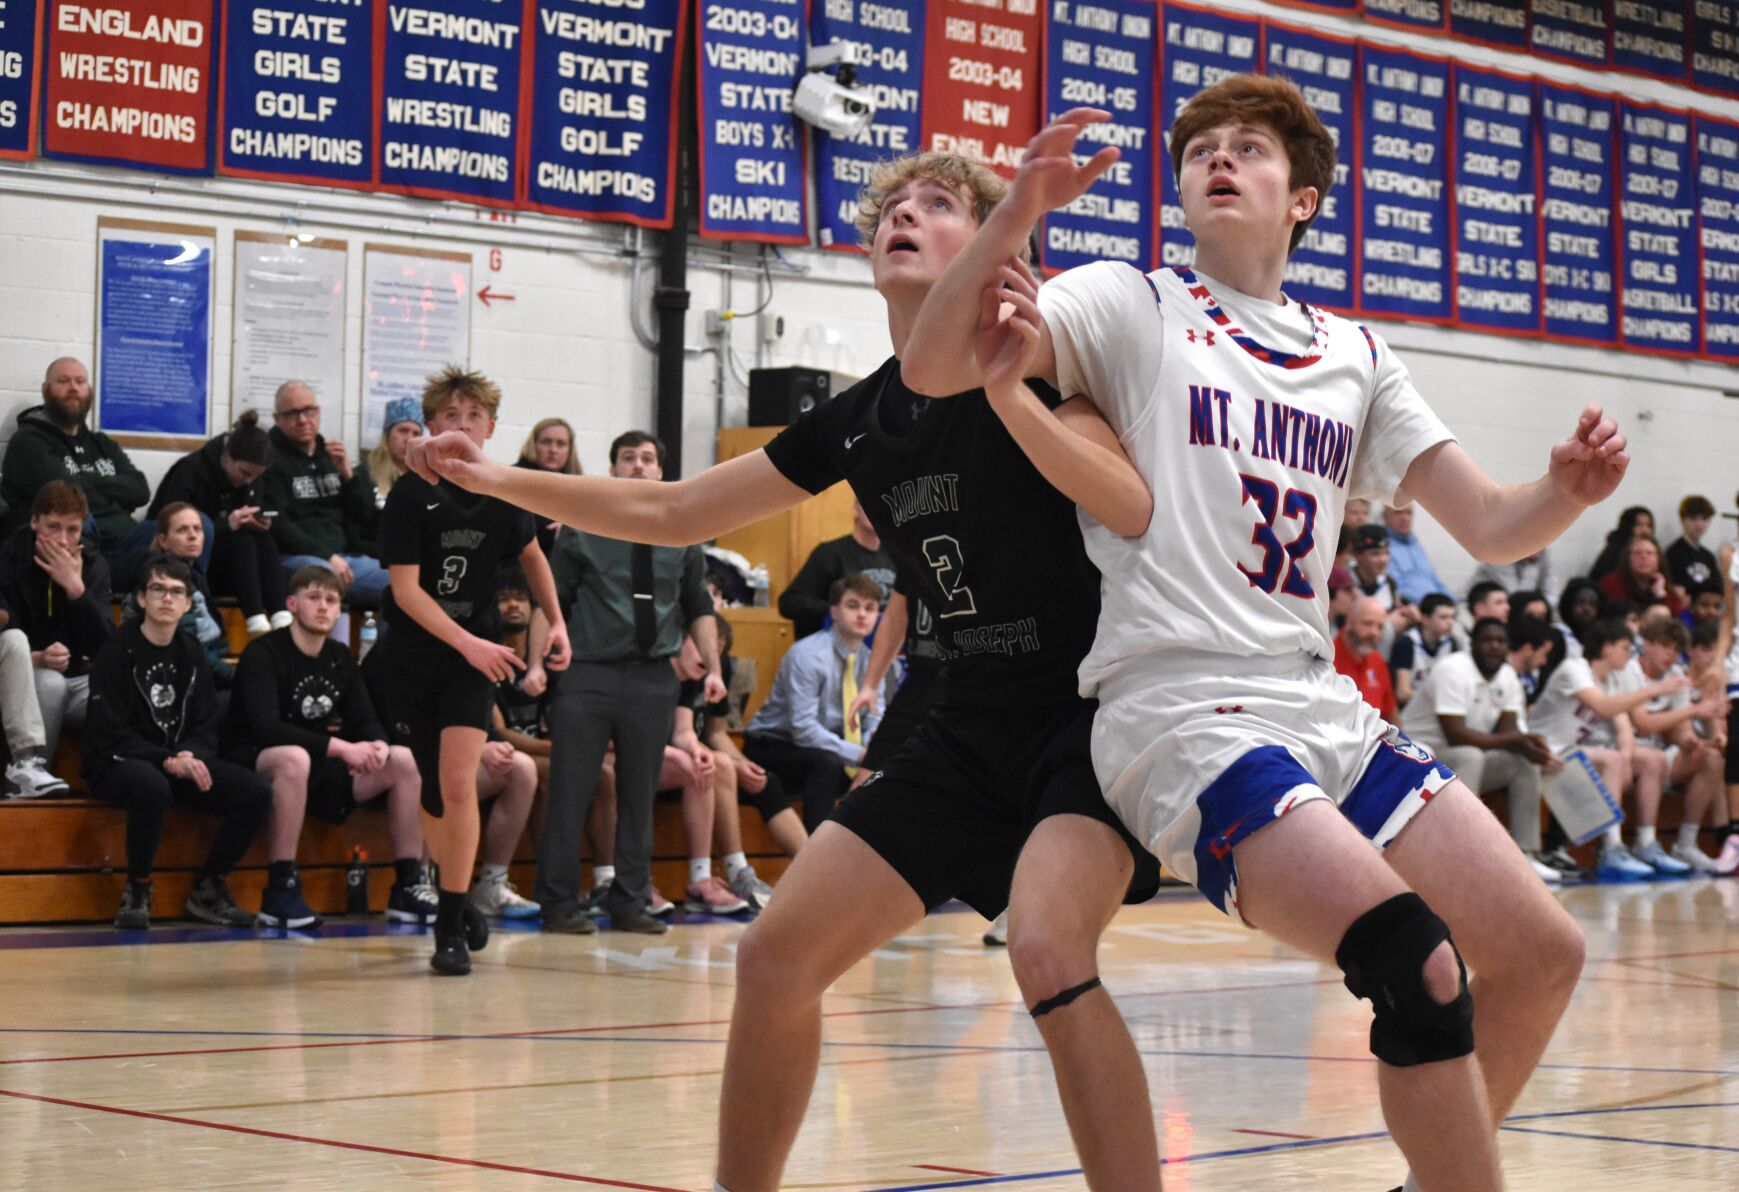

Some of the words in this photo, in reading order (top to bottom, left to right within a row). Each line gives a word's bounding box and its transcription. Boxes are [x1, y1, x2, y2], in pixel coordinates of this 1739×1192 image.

[58, 5, 203, 47] ENGLAND
[252, 8, 346, 45] STATE
[389, 5, 519, 49] VERMONT
[540, 8, 672, 53] VERMONT
[860, 1, 912, 34] SCHOOL
[60, 52, 199, 93] WRESTLING
[255, 50, 341, 84] GIRLS
[405, 54, 498, 92] STATE
[558, 51, 649, 88] STATE
[948, 56, 1023, 92] 2003-04
[255, 90, 337, 122] GOLF
[558, 87, 647, 122] GIRLS
[720, 81, 793, 113] STATE
[1061, 77, 1138, 112] 2004-05
[56, 101, 196, 143] CHAMPIONS
[387, 97, 511, 138] WRESTLING
[962, 98, 1010, 128] NEW
[230, 127, 362, 166] CHAMPIONS
[560, 126, 643, 157] GOLF
[715, 119, 764, 148] BOYS
[385, 142, 508, 182] CHAMPIONS
[735, 158, 785, 187] SKI
[1362, 166, 1444, 200] VERMONT
[1373, 203, 1433, 235] STATE
[1463, 219, 1524, 249] STATE
[1048, 226, 1141, 261] CHAMPIONS
[1547, 230, 1600, 260] STATE
[1627, 229, 1681, 258] STATE
[1362, 271, 1443, 304] CHAMPIONS
[1188, 383, 1241, 452] MT.
[1251, 397, 1354, 489] ANTHON
[881, 474, 958, 527] MOUNT
[1236, 471, 1318, 600] 32
[437, 554, 468, 595] 3
[922, 534, 977, 619] 2
